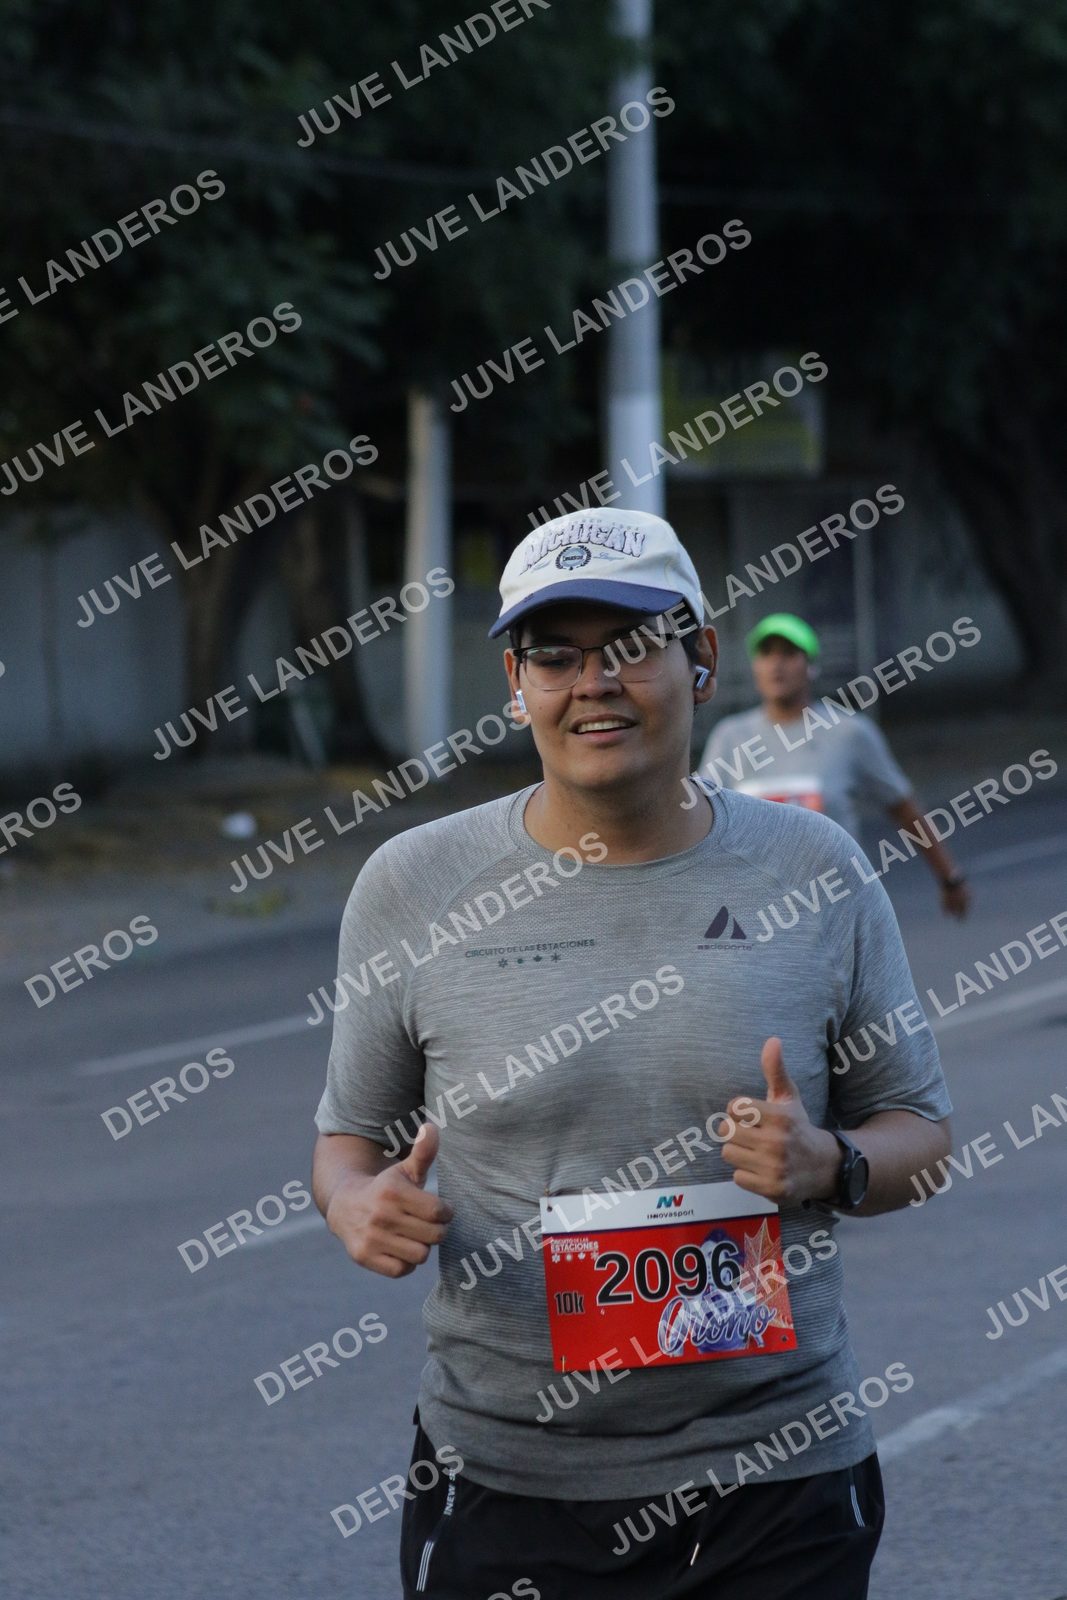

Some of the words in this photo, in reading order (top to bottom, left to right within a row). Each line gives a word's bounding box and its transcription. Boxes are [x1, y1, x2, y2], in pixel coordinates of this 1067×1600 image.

[521, 522, 646, 573] MICHIGAN
[465, 947, 506, 958] CIRCUITO
[507, 946, 518, 954] DE
[537, 939, 595, 951] ESTACIONES
[551, 1241, 599, 1252] ESTACIONES
[594, 1241, 742, 1306] 2096
